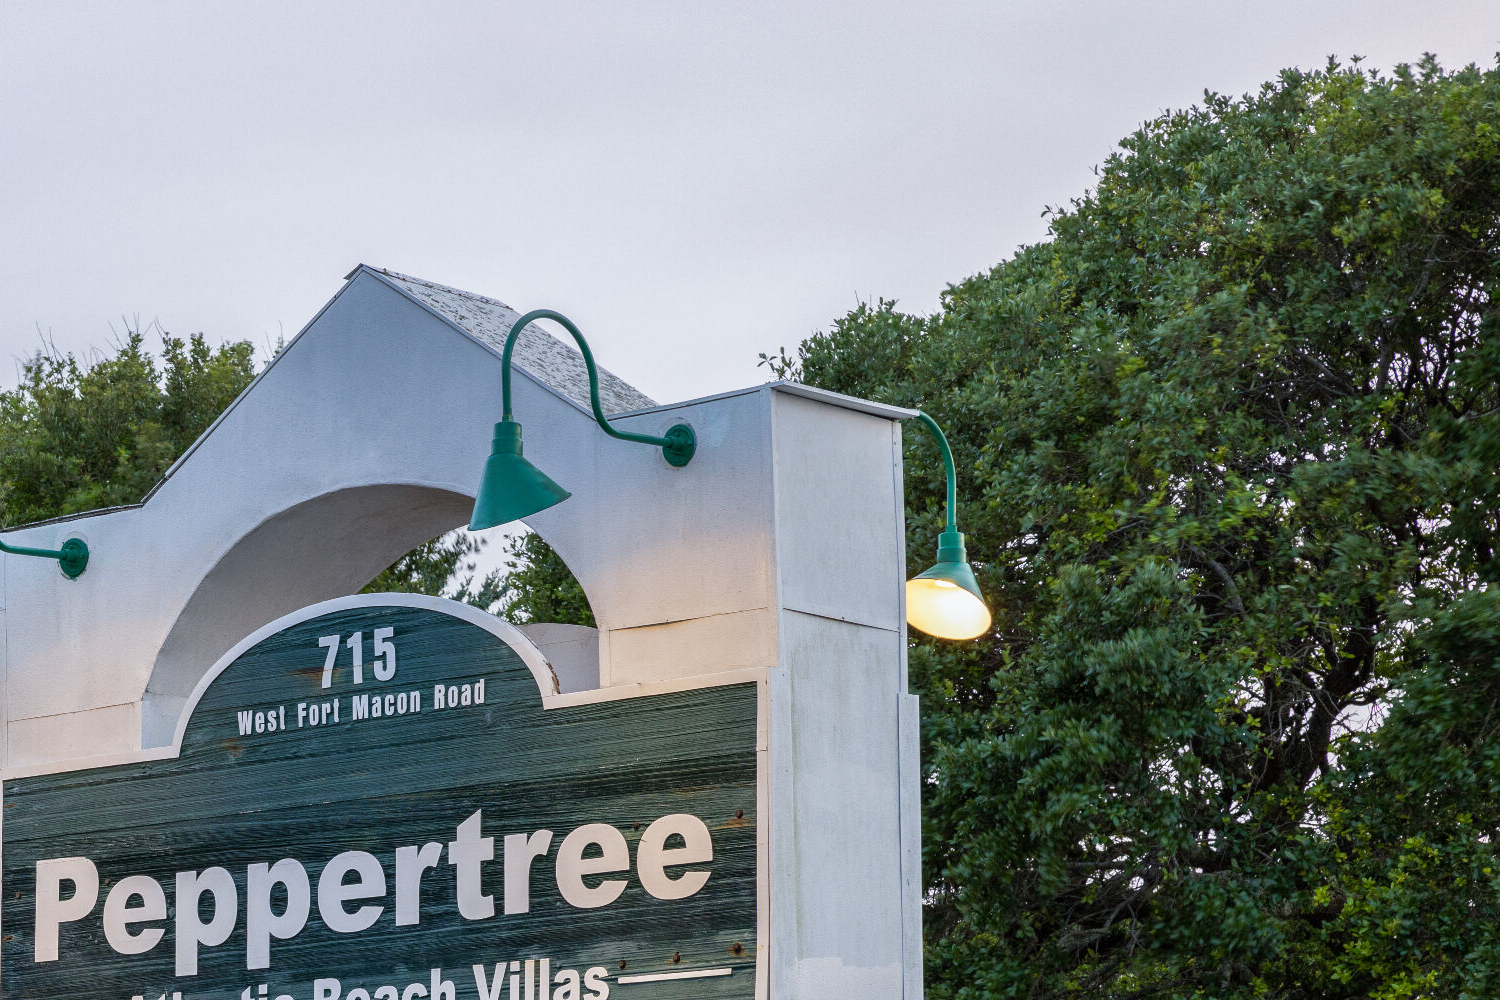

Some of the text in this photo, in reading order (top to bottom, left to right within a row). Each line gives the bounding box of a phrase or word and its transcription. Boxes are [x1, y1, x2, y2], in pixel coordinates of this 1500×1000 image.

[318, 627, 397, 689] 715
[237, 678, 485, 736] West Fort Macon Road
[34, 808, 714, 977] Peppertree
